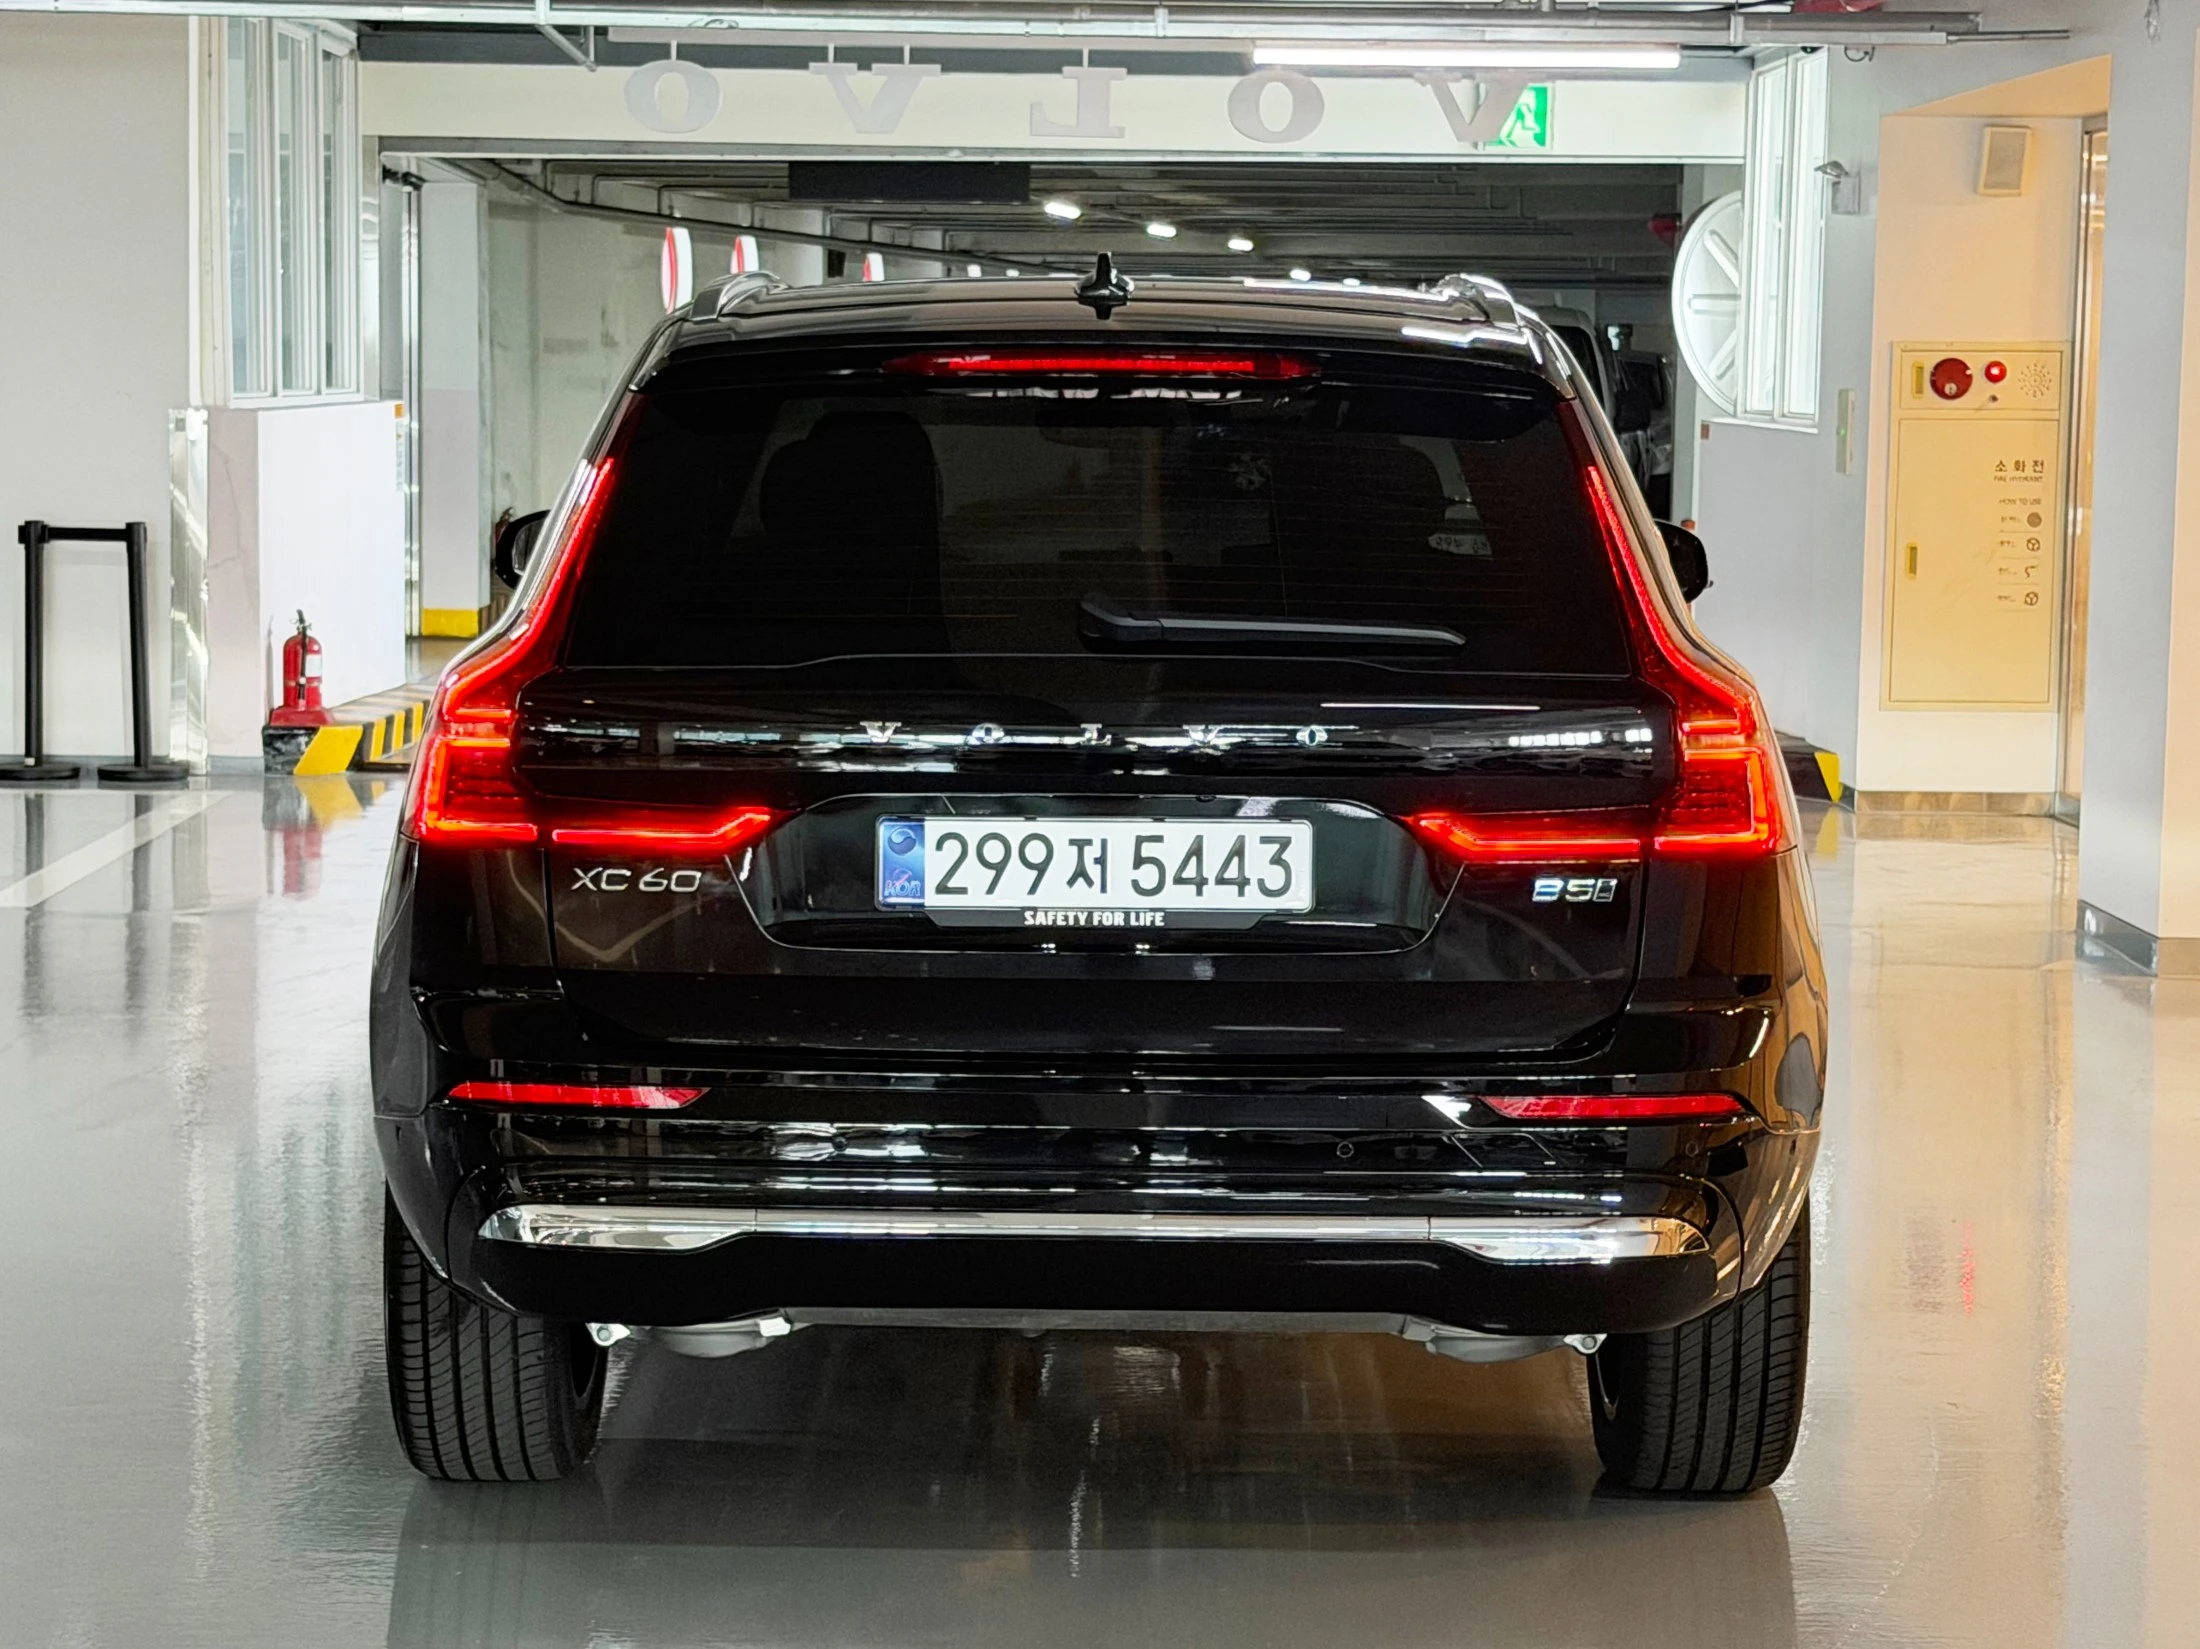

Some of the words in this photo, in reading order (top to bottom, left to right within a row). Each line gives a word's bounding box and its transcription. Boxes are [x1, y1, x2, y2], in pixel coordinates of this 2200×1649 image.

[860, 721, 1328, 746] VOLVO
[1131, 834, 1293, 898] 5443
[1024, 910, 1088, 926] SAFETY
[1092, 911, 1125, 926] FOR
[1129, 911, 1165, 927] LIFE
